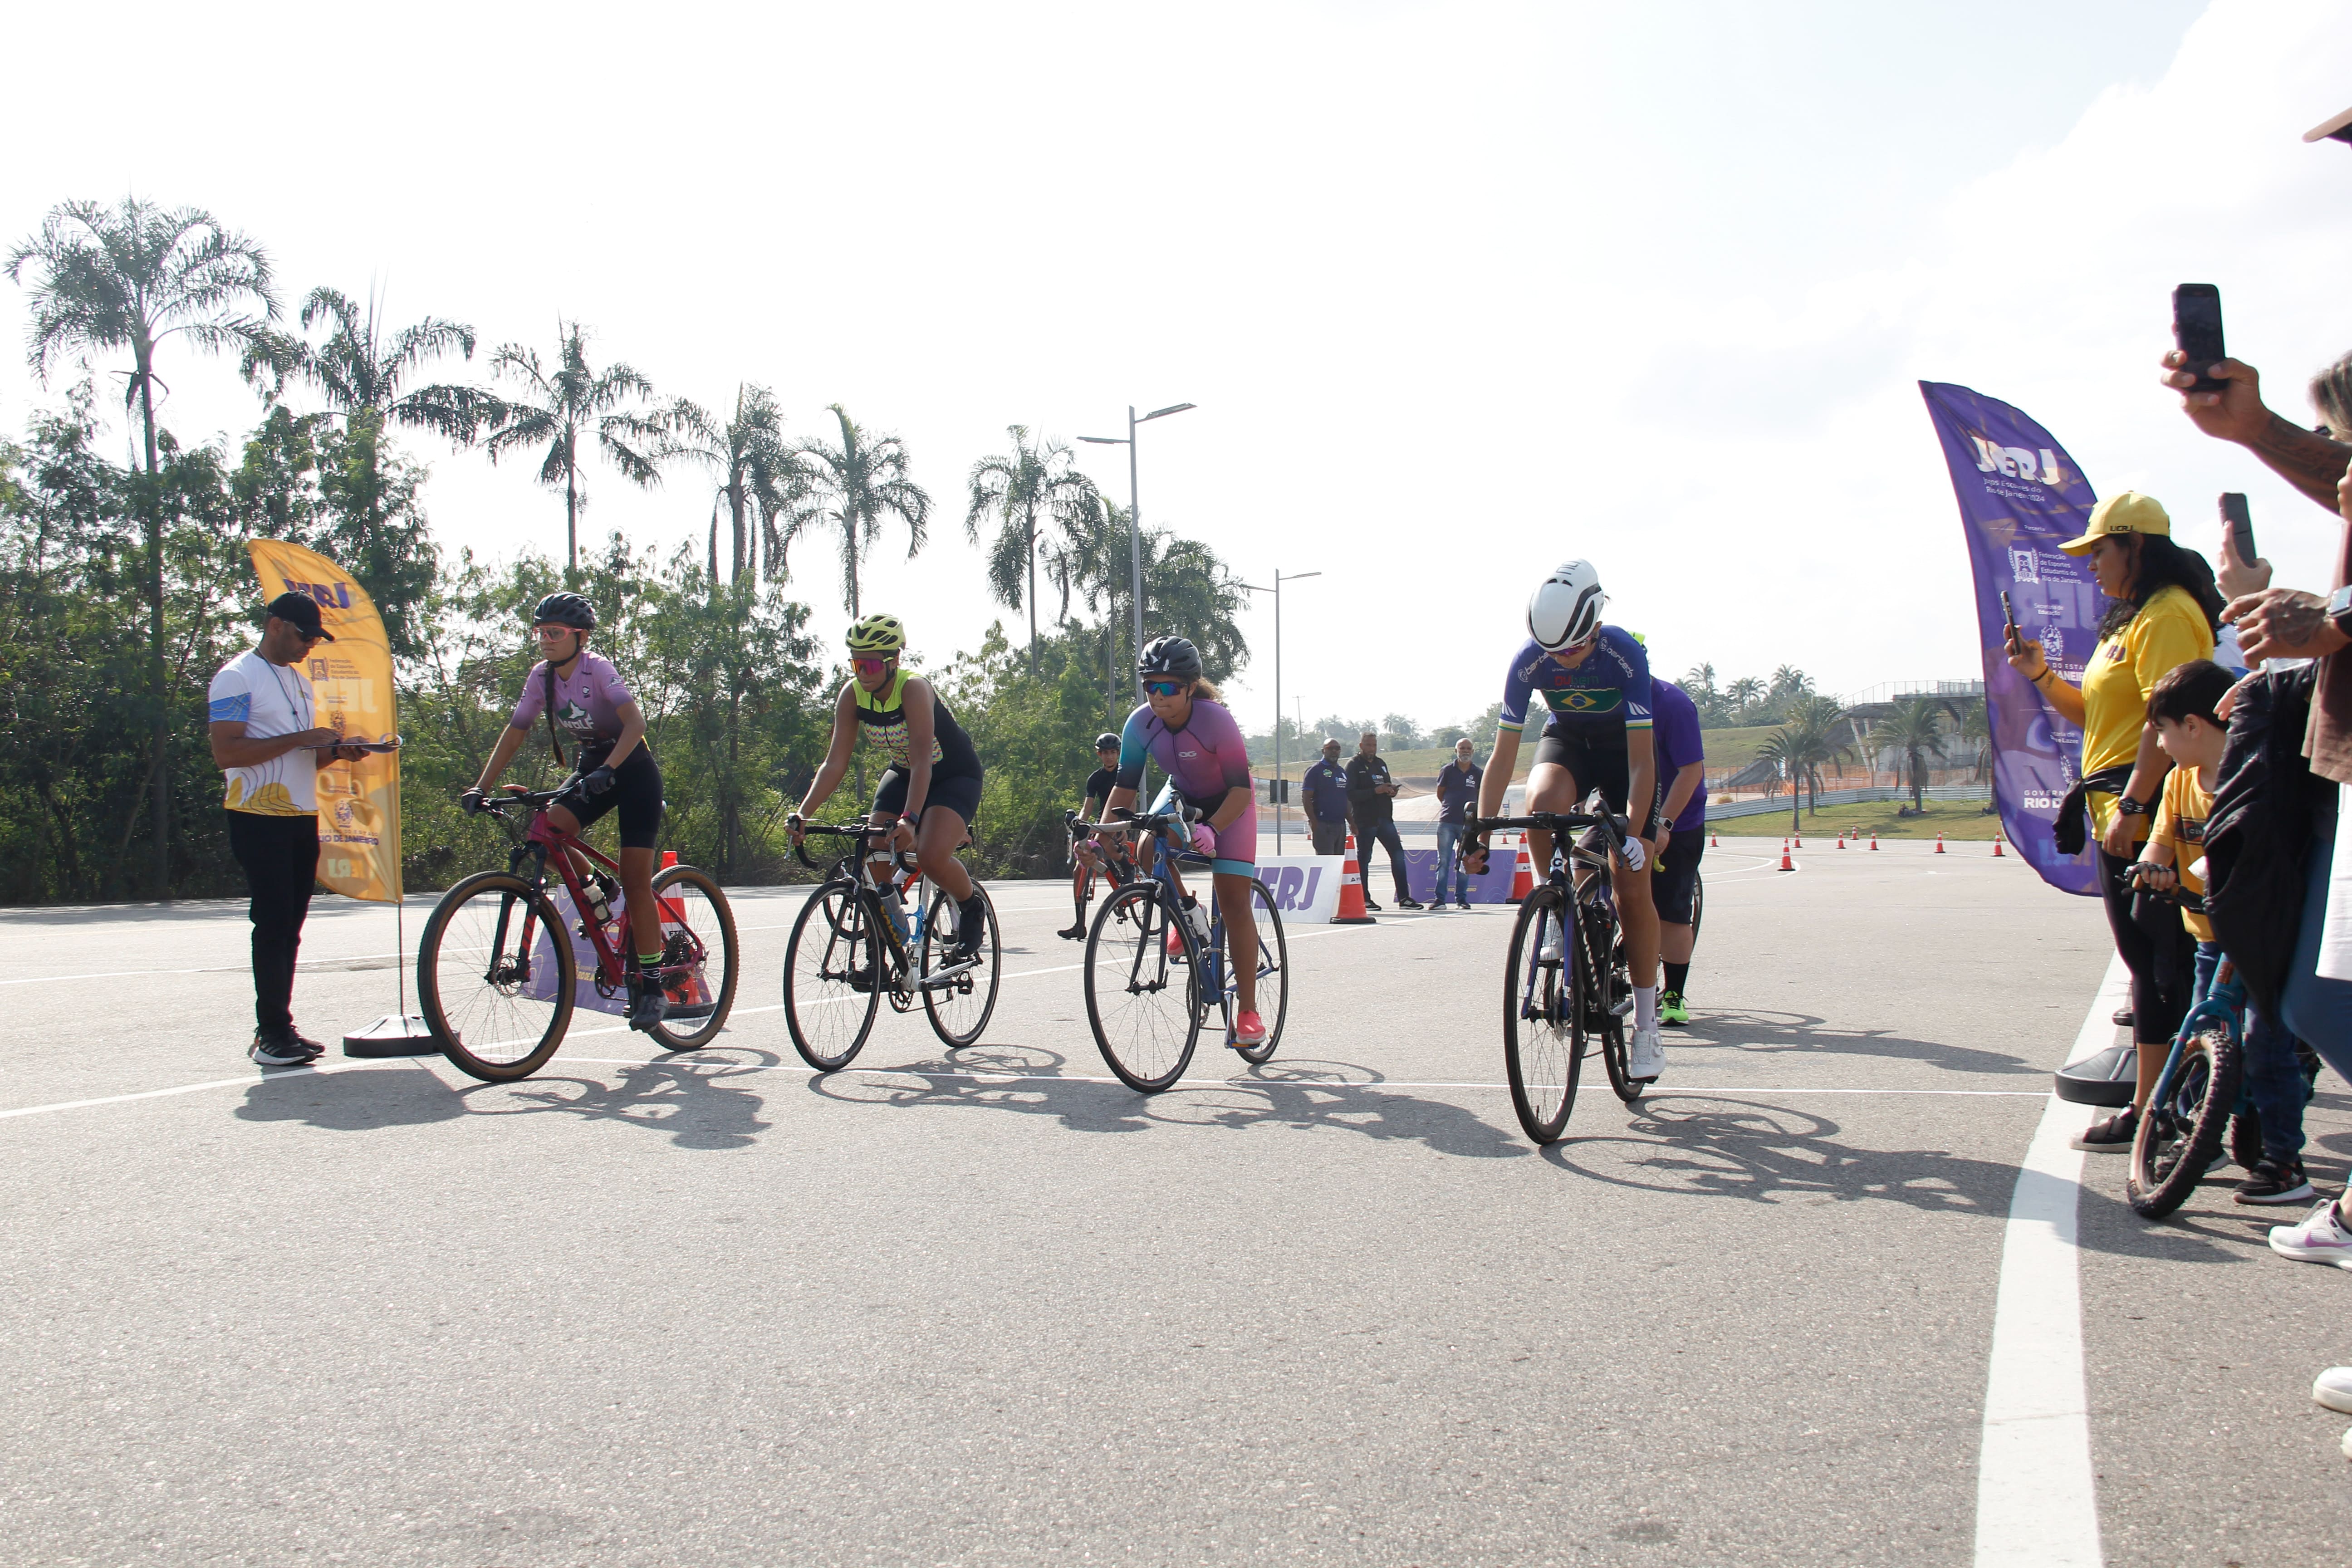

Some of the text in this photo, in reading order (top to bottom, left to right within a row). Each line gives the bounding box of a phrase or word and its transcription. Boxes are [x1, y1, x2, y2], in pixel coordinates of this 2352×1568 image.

[1970, 436, 2061, 485] JERJ
[2038, 552, 2066, 560] Federação
[2041, 568, 2068, 576] Estudantis
[1525, 652, 1549, 675] barte
[558, 713, 594, 730] WOLF
[2024, 798, 2063, 808] RIO D
[880, 905, 902, 948] CALOI
